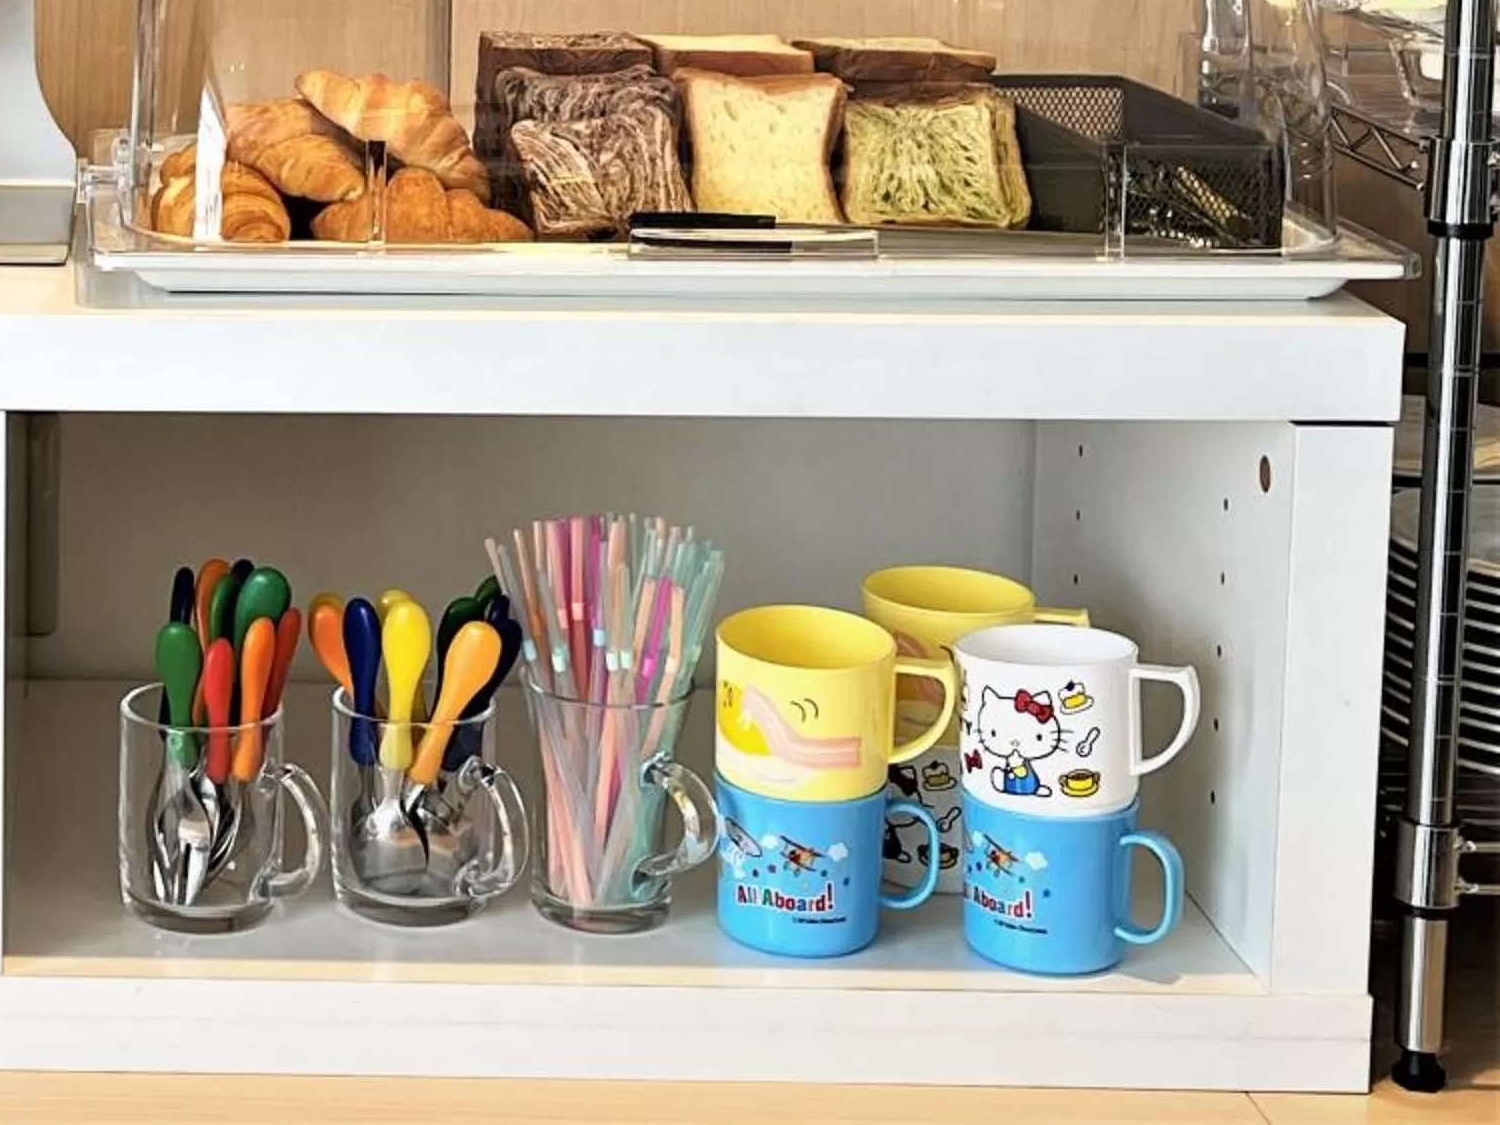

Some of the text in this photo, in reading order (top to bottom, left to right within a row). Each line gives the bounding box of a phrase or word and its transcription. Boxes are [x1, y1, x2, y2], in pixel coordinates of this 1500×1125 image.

[738, 882, 833, 912] All Aboard!
[973, 885, 1033, 919] Aboard!
